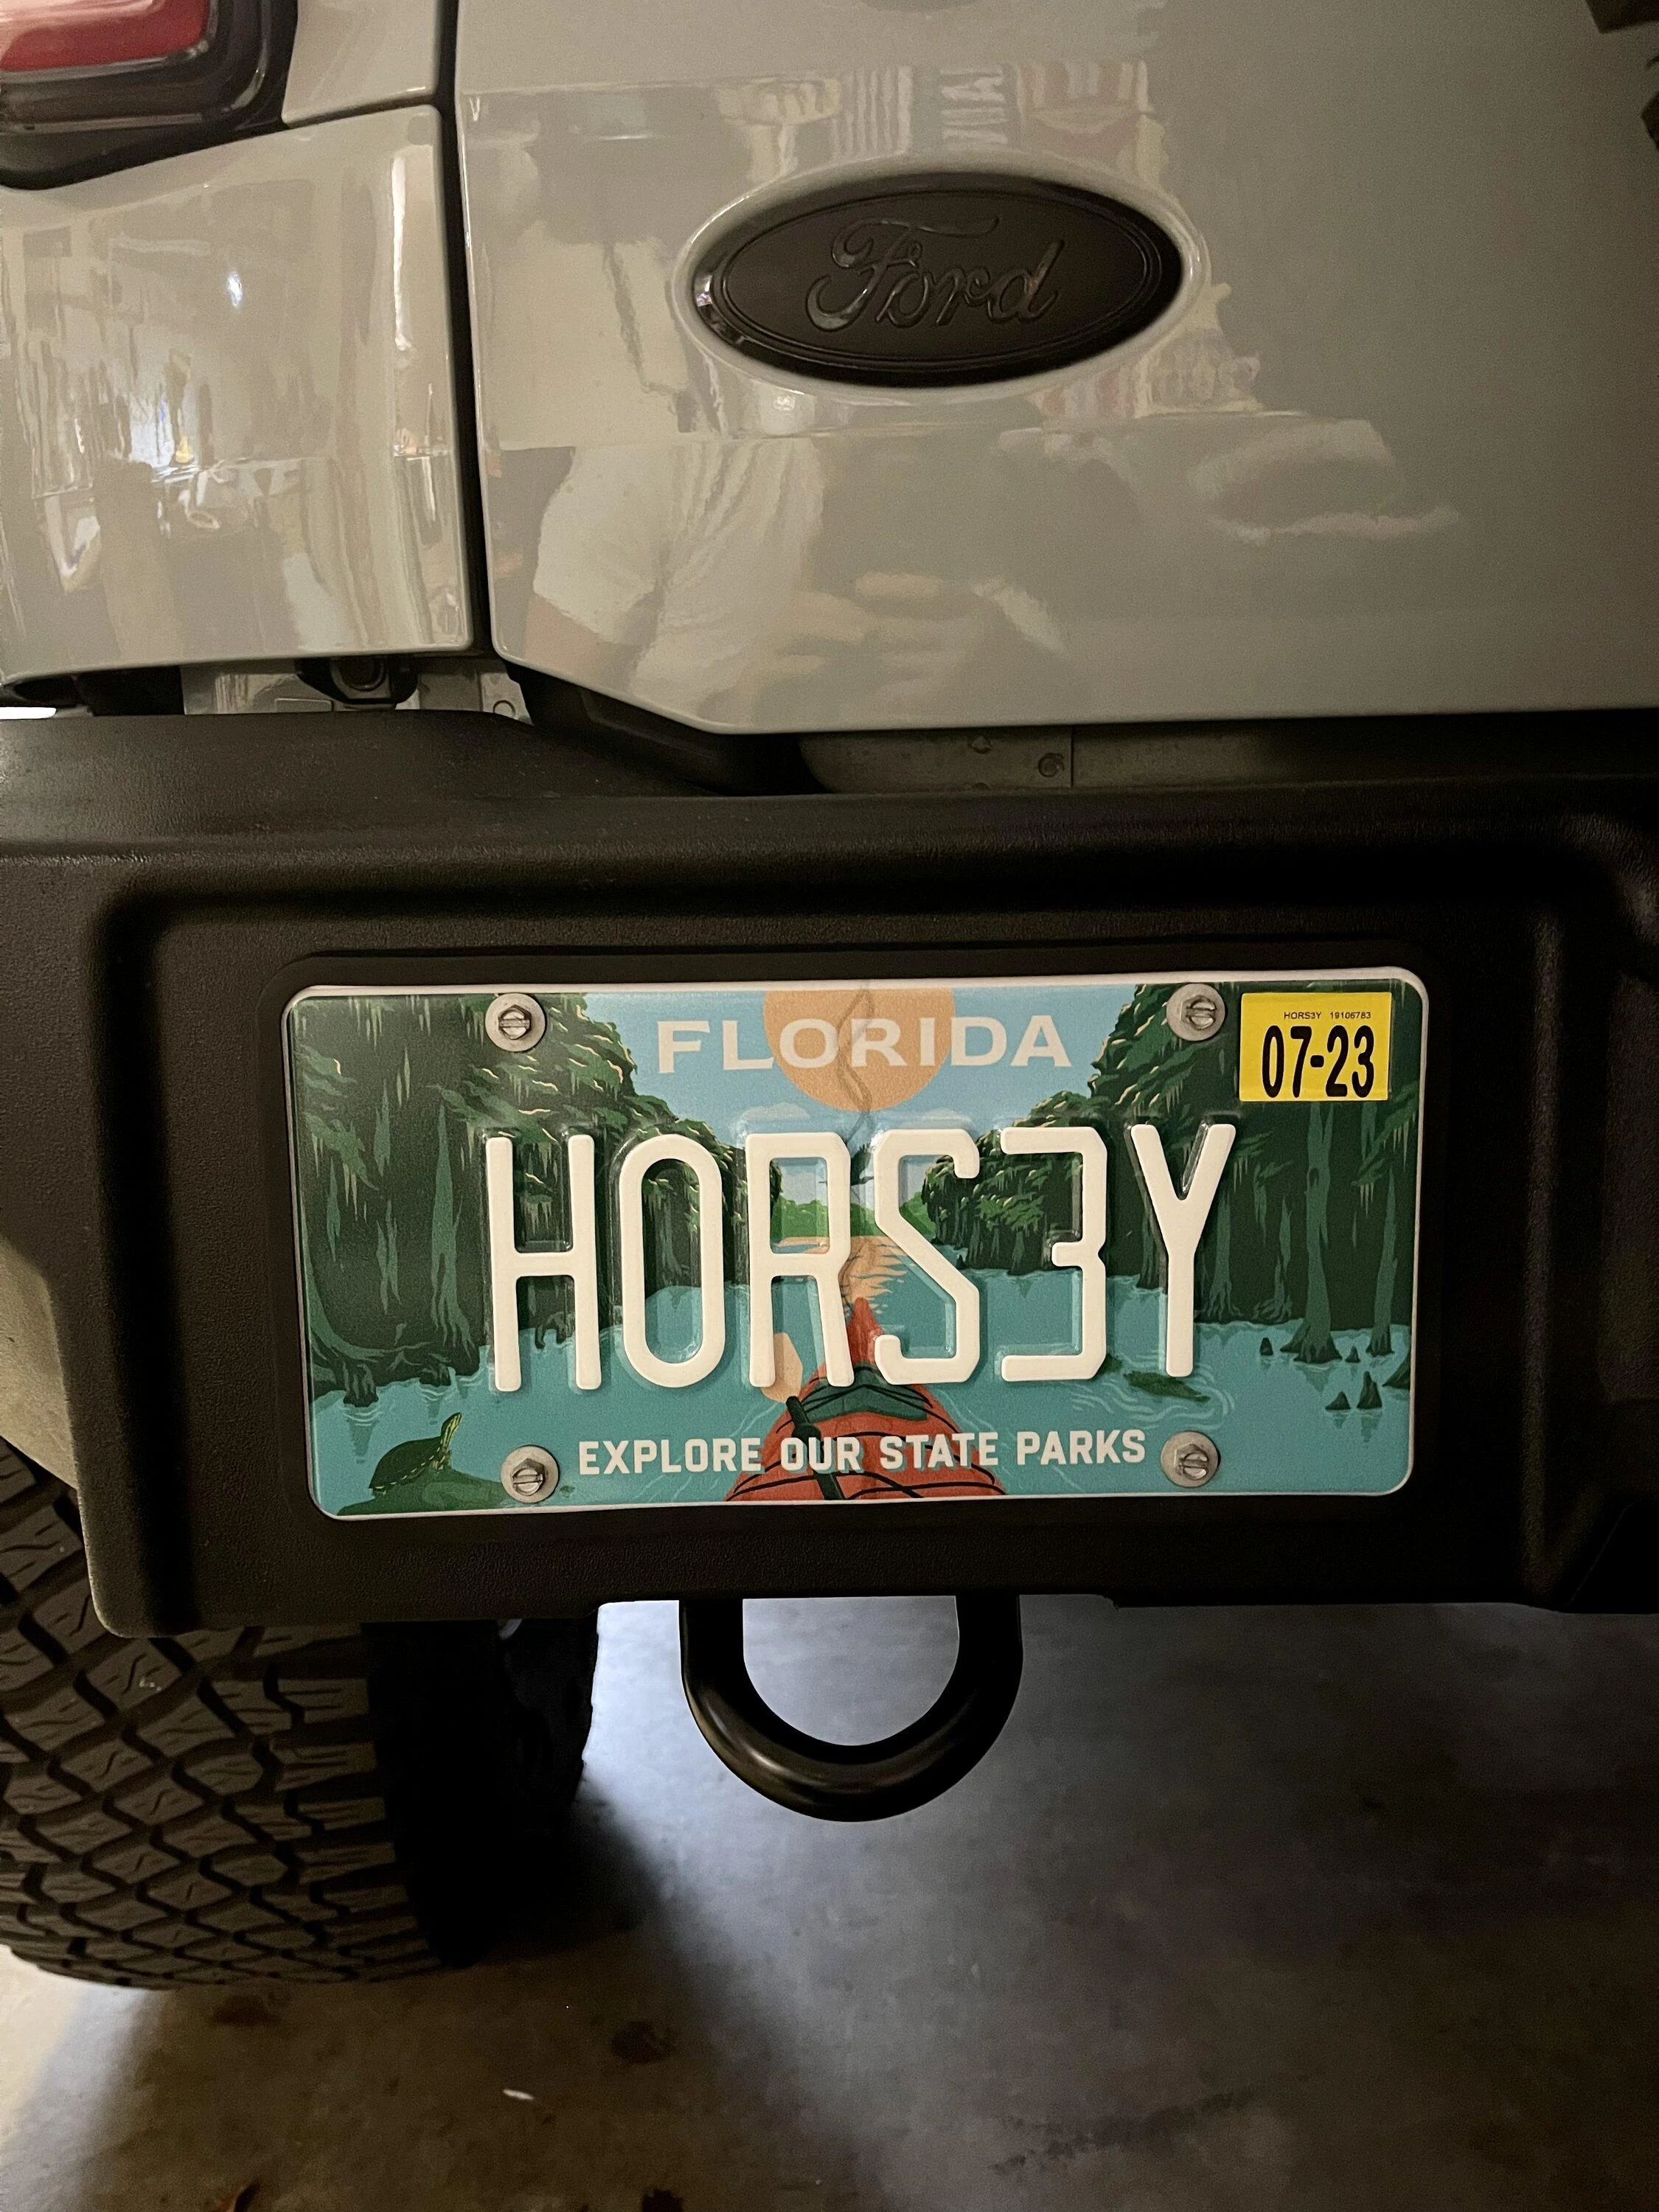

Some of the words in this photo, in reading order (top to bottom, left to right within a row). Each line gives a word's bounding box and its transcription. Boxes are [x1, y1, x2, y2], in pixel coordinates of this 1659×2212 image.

[805, 217, 1065, 332] Ford
[656, 1015, 1073, 1074] FLORIDA
[1284, 1012, 1322, 1020] HORS3Y
[1329, 1012, 1371, 1020] 19106783
[1262, 1025, 1374, 1098] 07-23
[485, 1124, 1236, 1392] HORS3Y
[578, 1437, 765, 1475] EXPLORE
[780, 1436, 863, 1472] OUR
[879, 1431, 999, 1469] STATE
[1016, 1429, 1147, 1467] PARKS
